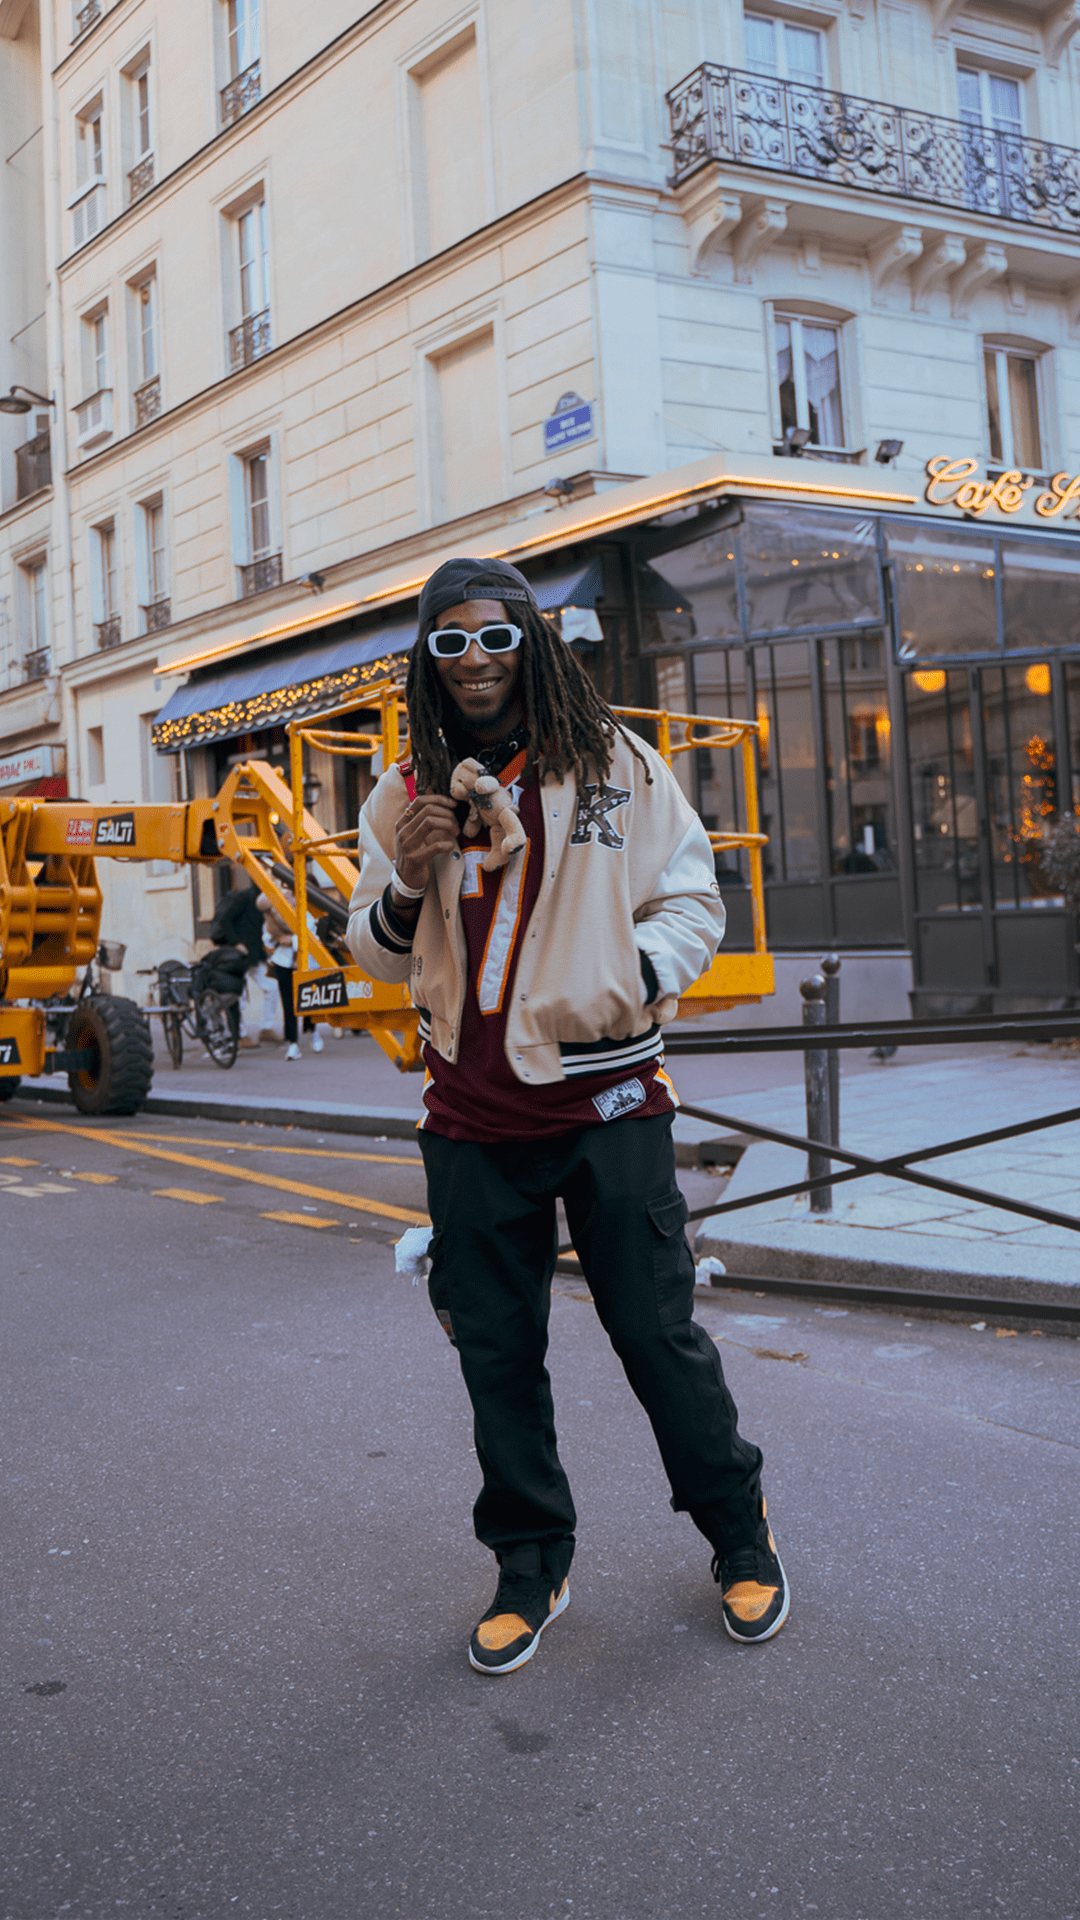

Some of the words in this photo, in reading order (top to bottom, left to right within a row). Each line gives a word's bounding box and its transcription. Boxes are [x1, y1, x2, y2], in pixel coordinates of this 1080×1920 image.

[925, 455, 1034, 518] Café
[1033, 472, 1080, 518] S
[96, 821, 133, 843] SALTI
[569, 784, 633, 851] K
[300, 983, 342, 1008] SALTI
